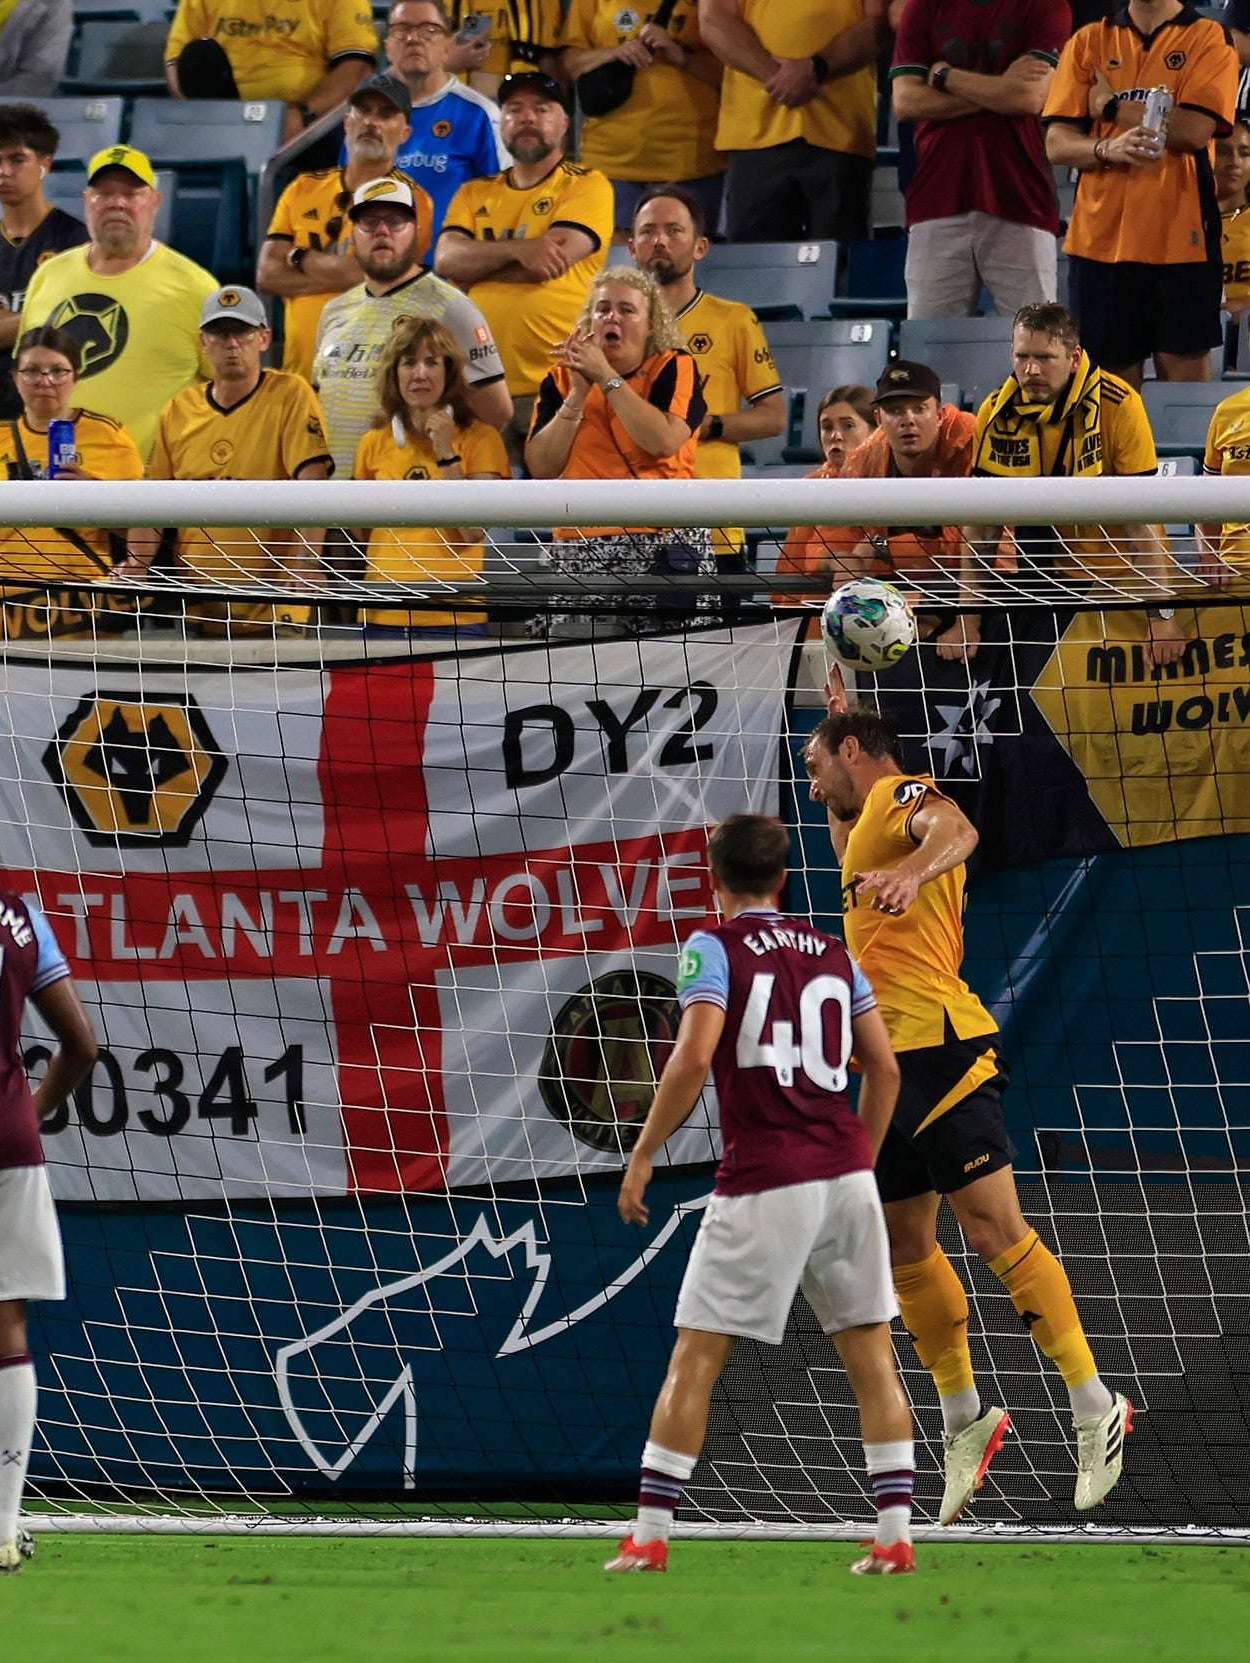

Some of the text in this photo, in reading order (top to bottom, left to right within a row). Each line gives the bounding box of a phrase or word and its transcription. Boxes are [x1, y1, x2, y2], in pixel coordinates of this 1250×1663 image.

[502, 679, 719, 790] DY2
[20, 850, 709, 962] TLANTA WOLVE
[742, 927, 828, 957] EARTHY
[735, 971, 854, 1093] 40
[963, 1152, 990, 1174] SUDU
